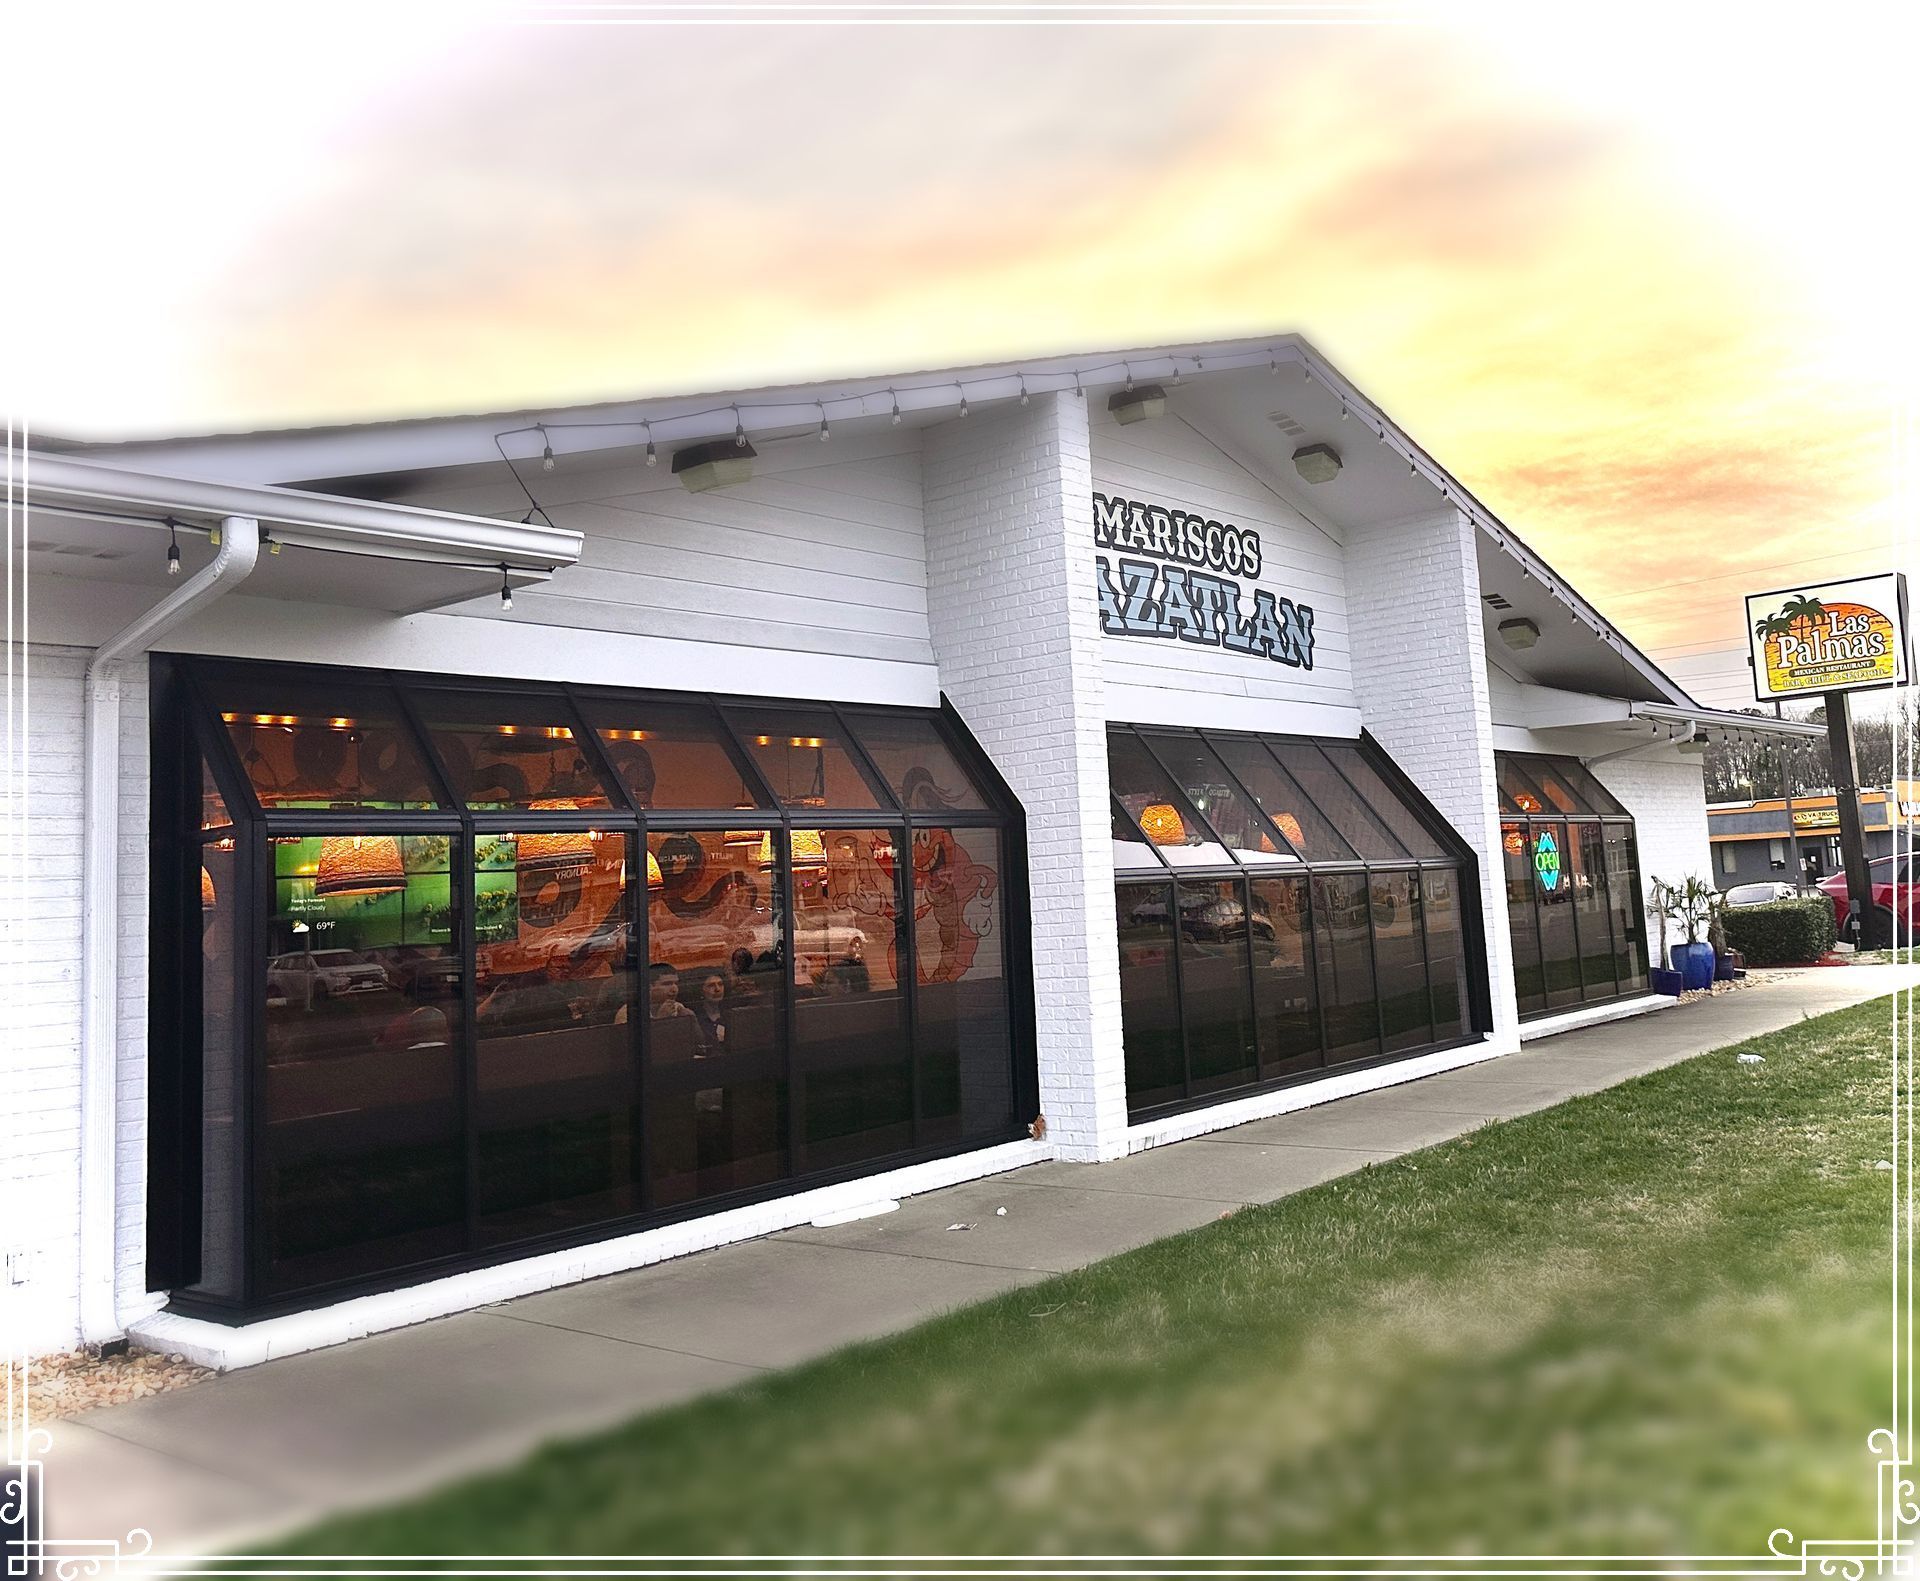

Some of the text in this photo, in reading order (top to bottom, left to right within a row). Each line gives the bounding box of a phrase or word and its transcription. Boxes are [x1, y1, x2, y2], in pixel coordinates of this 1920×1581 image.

[1092, 492, 1262, 579] MARISCOS
[1828, 611, 1871, 637] Las
[1777, 628, 1886, 669] Palmas
[1794, 661, 1871, 676] MEXICAN RESTAURANT
[1805, 674, 1832, 685] GRILL
[1842, 668, 1884, 680] SEAFOOD
[1536, 851, 1560, 871] OPEN
[307, 904, 326, 912] Cloudy
[316, 921, 336, 931] 69°F
